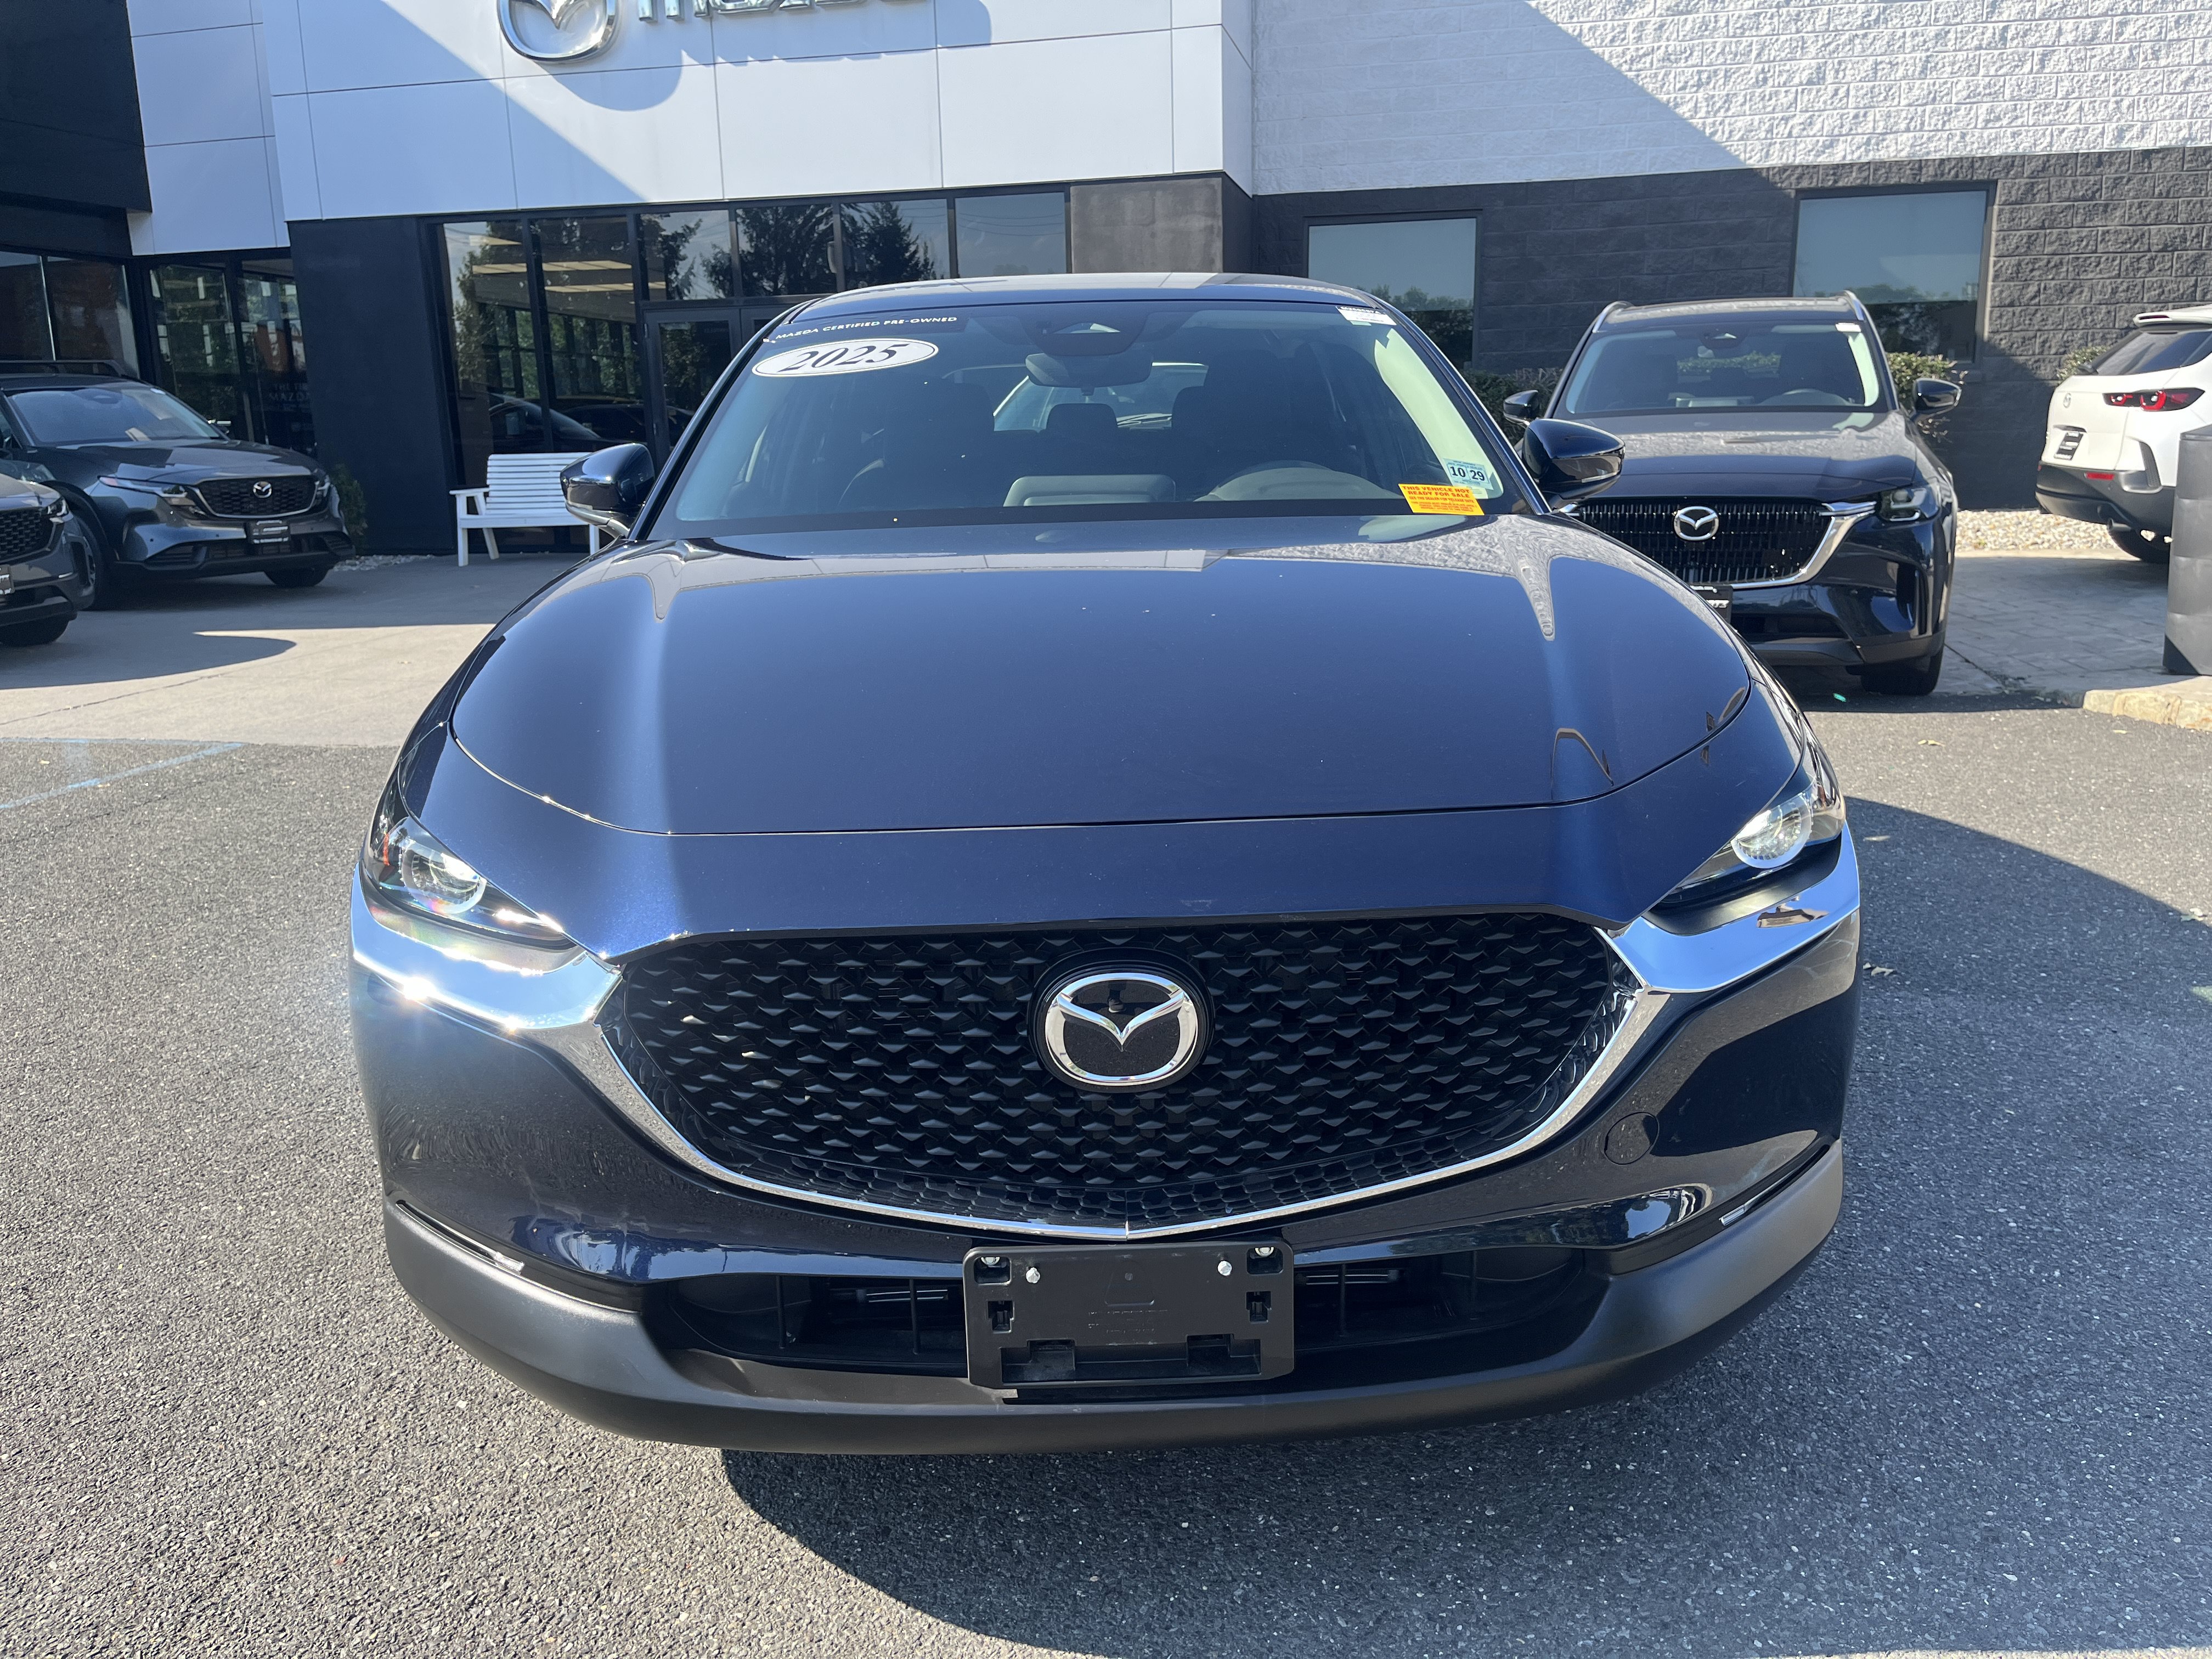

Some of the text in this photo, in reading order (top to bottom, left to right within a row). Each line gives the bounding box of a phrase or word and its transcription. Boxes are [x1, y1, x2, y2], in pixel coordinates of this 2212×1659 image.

[775, 317, 957, 340] MAZDA CERTIFIED PRE-OWNED
[776, 343, 910, 373] 2025
[1450, 466, 1466, 478] 10
[1469, 469, 1486, 481] 29
